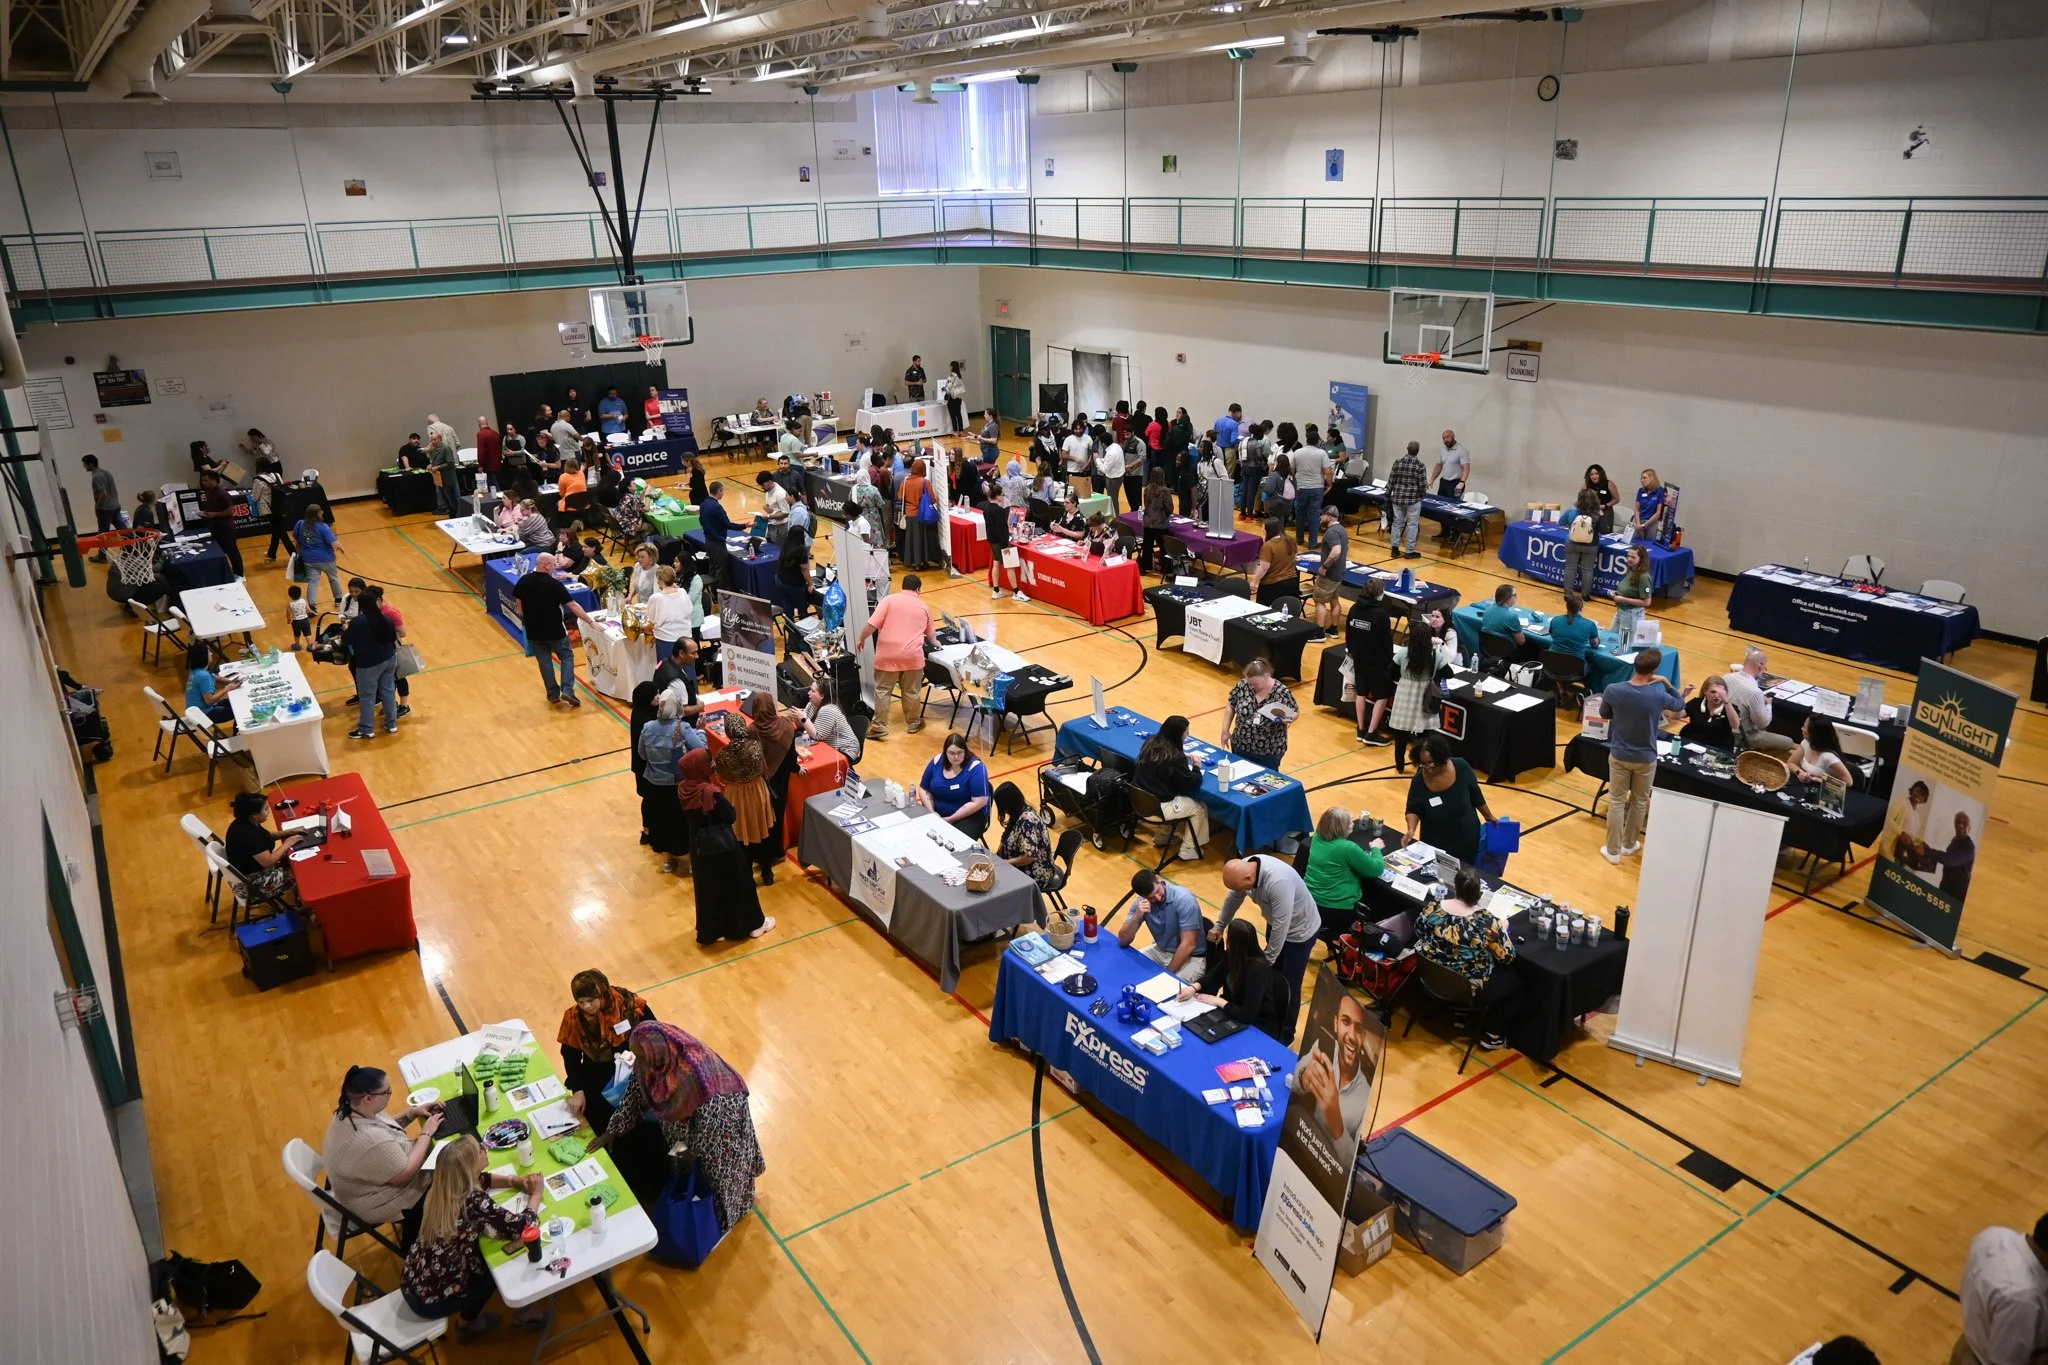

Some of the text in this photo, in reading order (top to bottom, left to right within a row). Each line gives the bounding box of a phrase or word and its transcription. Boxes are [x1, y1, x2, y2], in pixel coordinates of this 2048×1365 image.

[1510, 368, 1535, 377] DUNKING
[1519, 359, 1528, 367] NO
[627, 451, 668, 466] apace
[814, 496, 845, 512] WARHOR
[1526, 535, 1629, 576] prous
[1019, 558, 1037, 587] N
[1792, 598, 1808, 607] Office
[722, 607, 741, 628] Nye
[740, 618, 754, 627] Health
[754, 621, 771, 631] Services
[743, 654, 771, 667] PURPOSEFUL
[743, 667, 770, 679] PASSIONATE
[744, 680, 771, 692] RESPONSIVE
[1919, 705, 1993, 746] SUNLIGHT
[1922, 740, 1948, 755] caregivers
[1958, 756, 1969, 766] help
[1943, 731, 1994, 758] SENIOR CARE
[1884, 869, 1952, 913] 402-200-5555
[485, 1032, 513, 1042] EMPLOYER
[1080, 1044, 1109, 1069] EMPLOYMENT
[1299, 1117, 1344, 1175] Work just became
[1300, 1132, 1308, 1147] lot
[1308, 1141, 1319, 1159] less
[1283, 1182, 1306, 1214] Introducing
